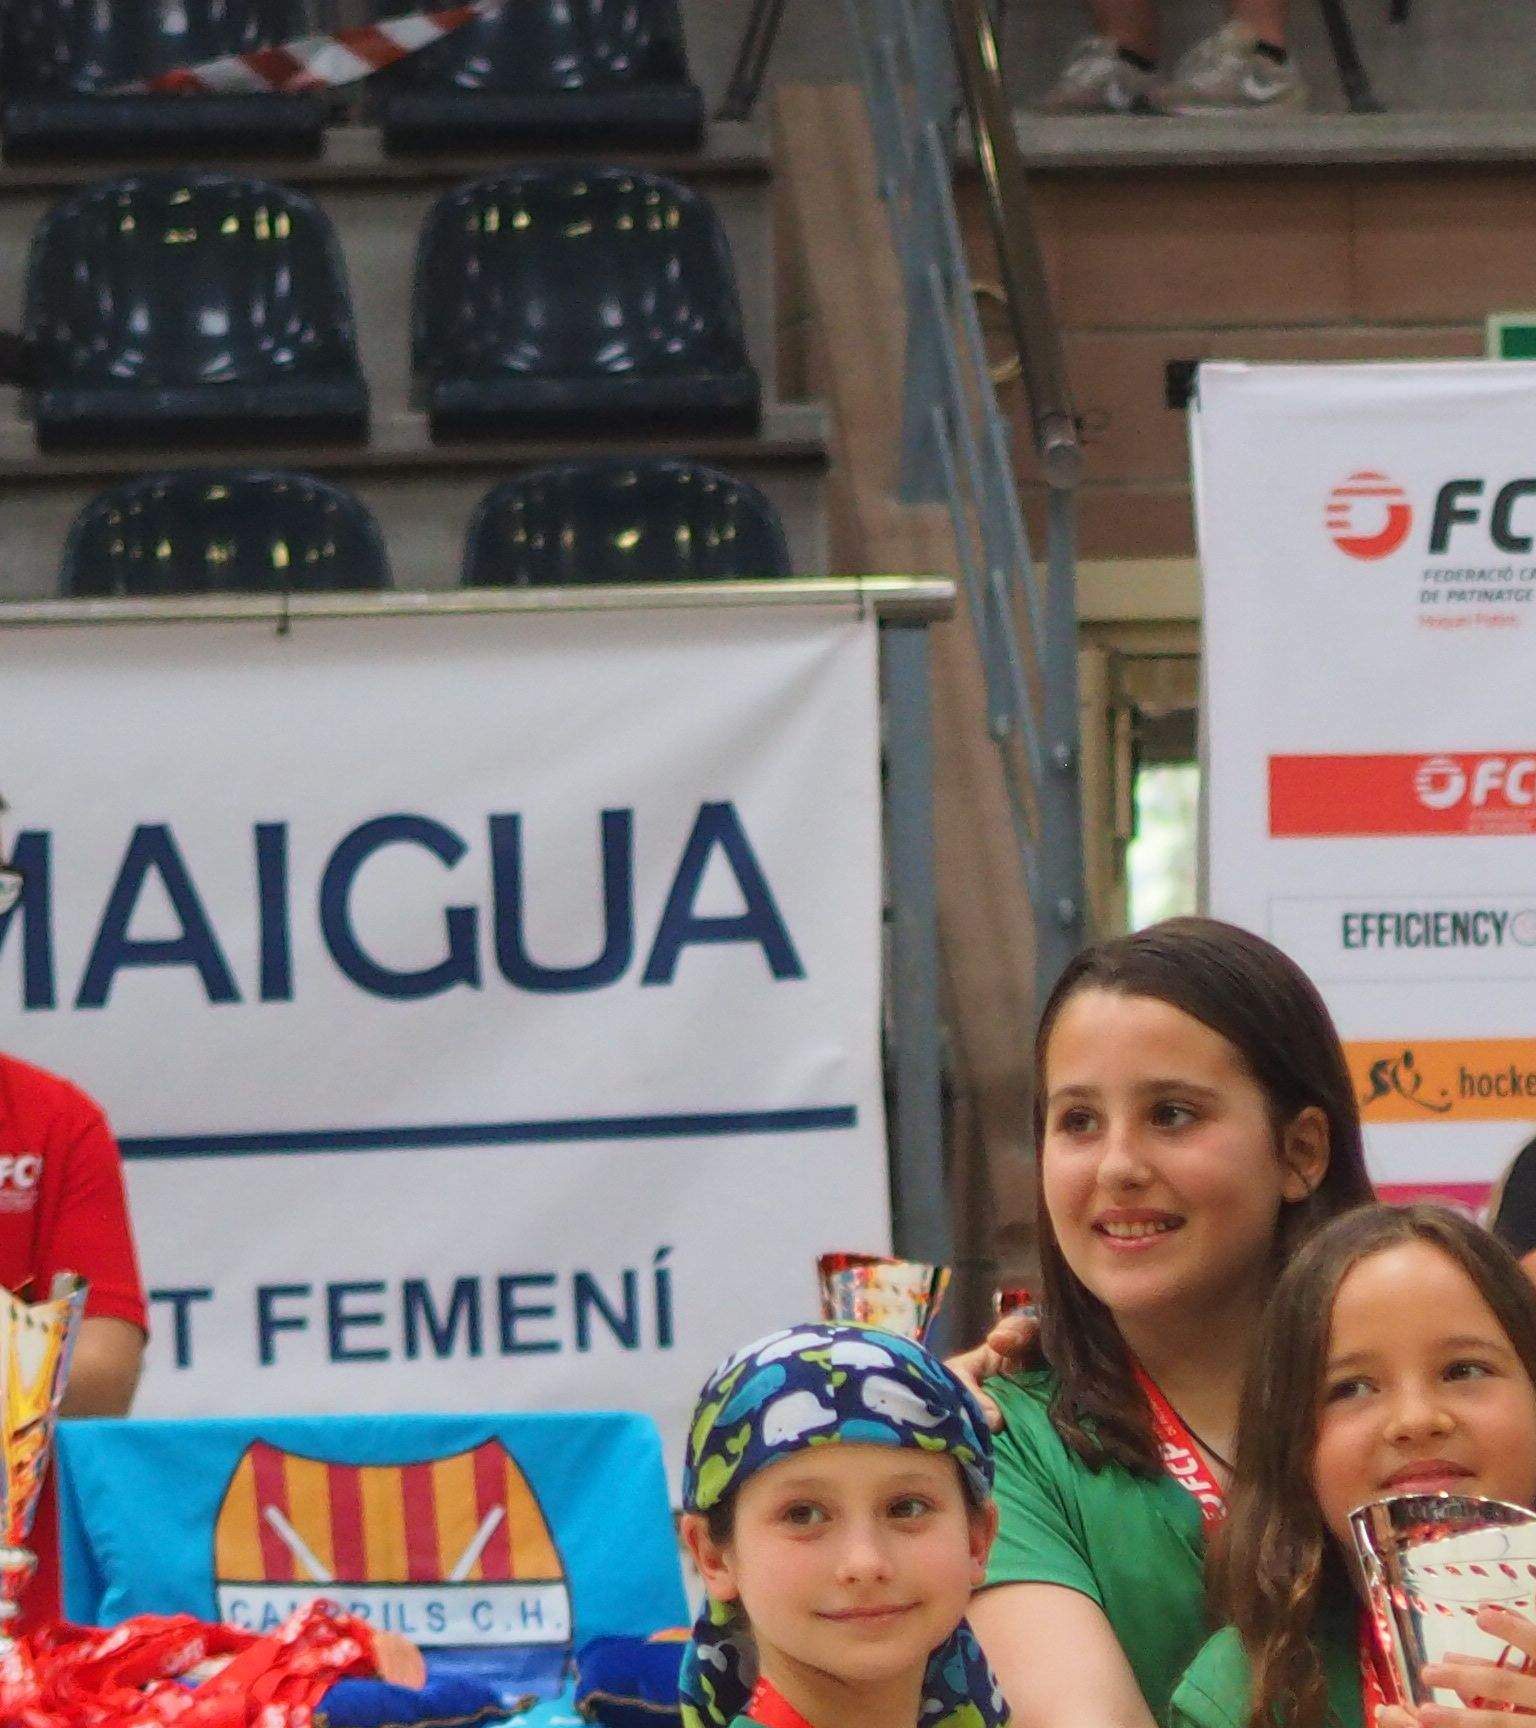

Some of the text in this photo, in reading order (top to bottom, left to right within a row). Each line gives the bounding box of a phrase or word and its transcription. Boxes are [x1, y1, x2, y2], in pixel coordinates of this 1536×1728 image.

[1342, 910, 1509, 949] EFFICIENCY
[255, 1248, 675, 1366] FEMENÍ
[1159, 1442, 1213, 1491] FCP
